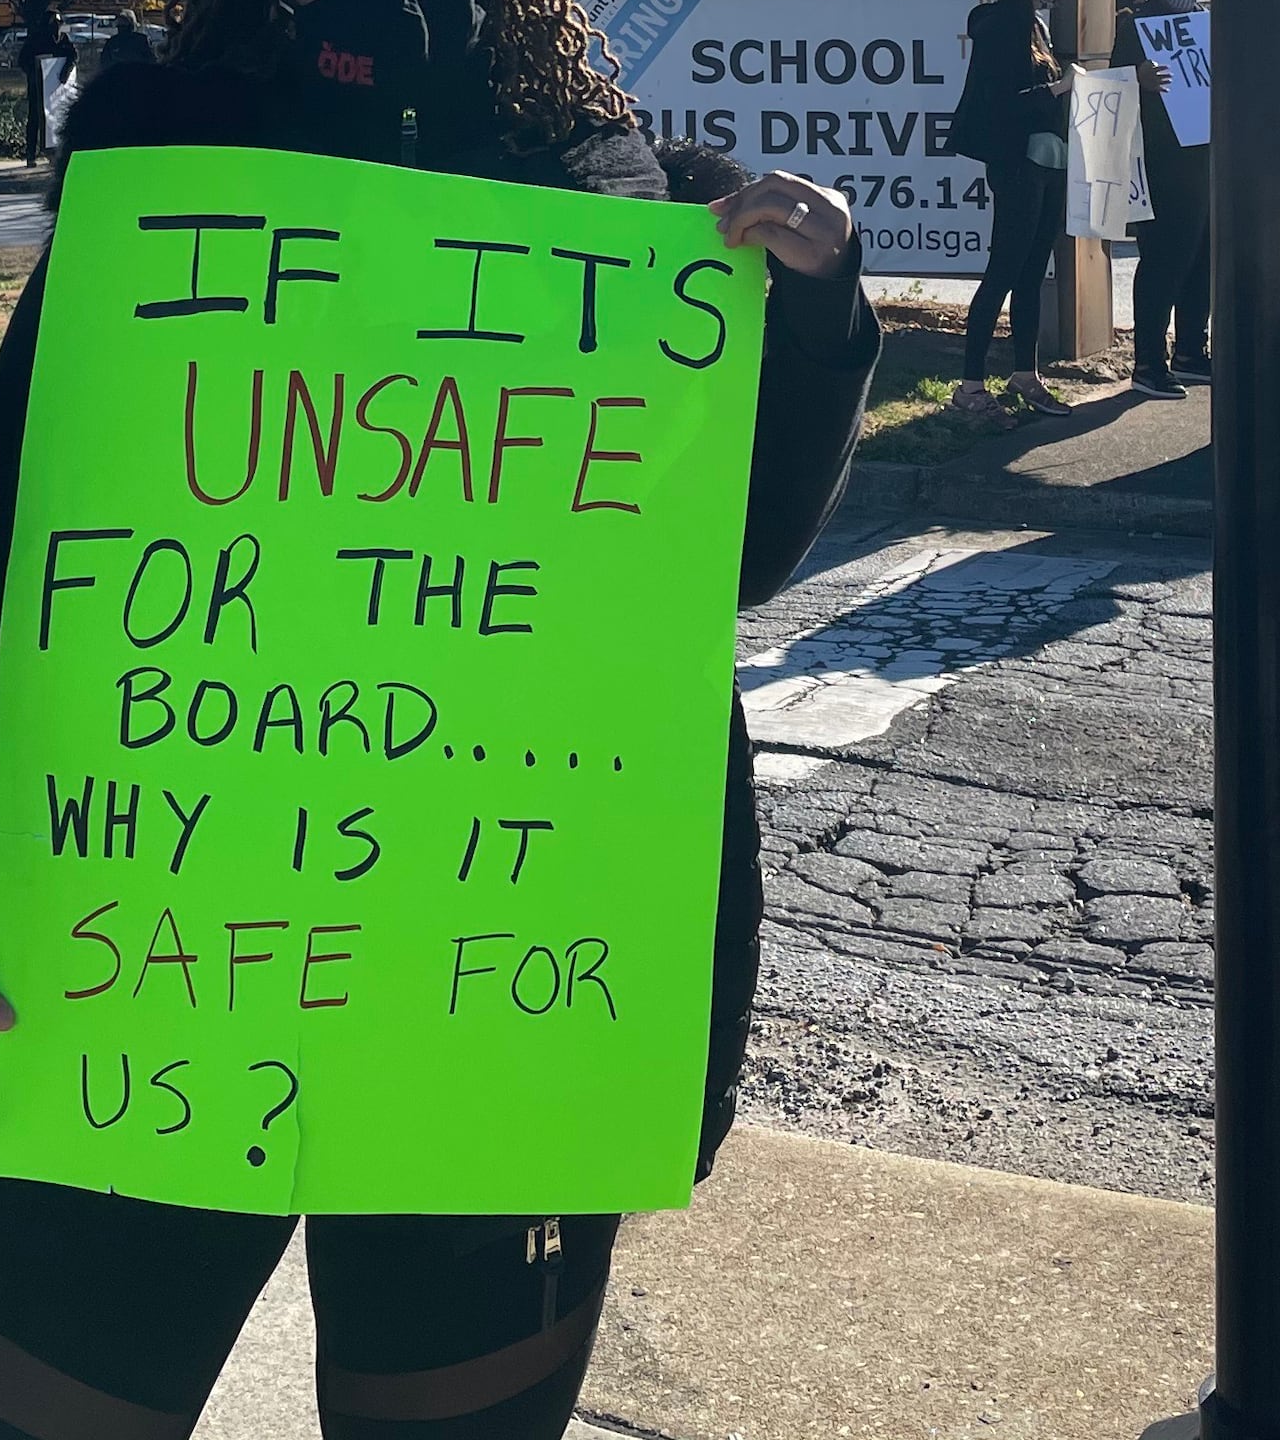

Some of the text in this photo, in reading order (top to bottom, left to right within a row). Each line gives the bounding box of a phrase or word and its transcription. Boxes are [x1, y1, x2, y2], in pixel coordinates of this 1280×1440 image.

[691, 38, 944, 85] SCHOOL
[1141, 16, 1196, 51] WE
[761, 110, 957, 157] DRIVE
[133, 214, 734, 369] IF IT'S
[184, 361, 646, 514] UNSAFE
[38, 528, 541, 655] FOR THE
[46, 774, 555, 885] WHY IS IT
[64, 901, 617, 1022] SAFE FOR
